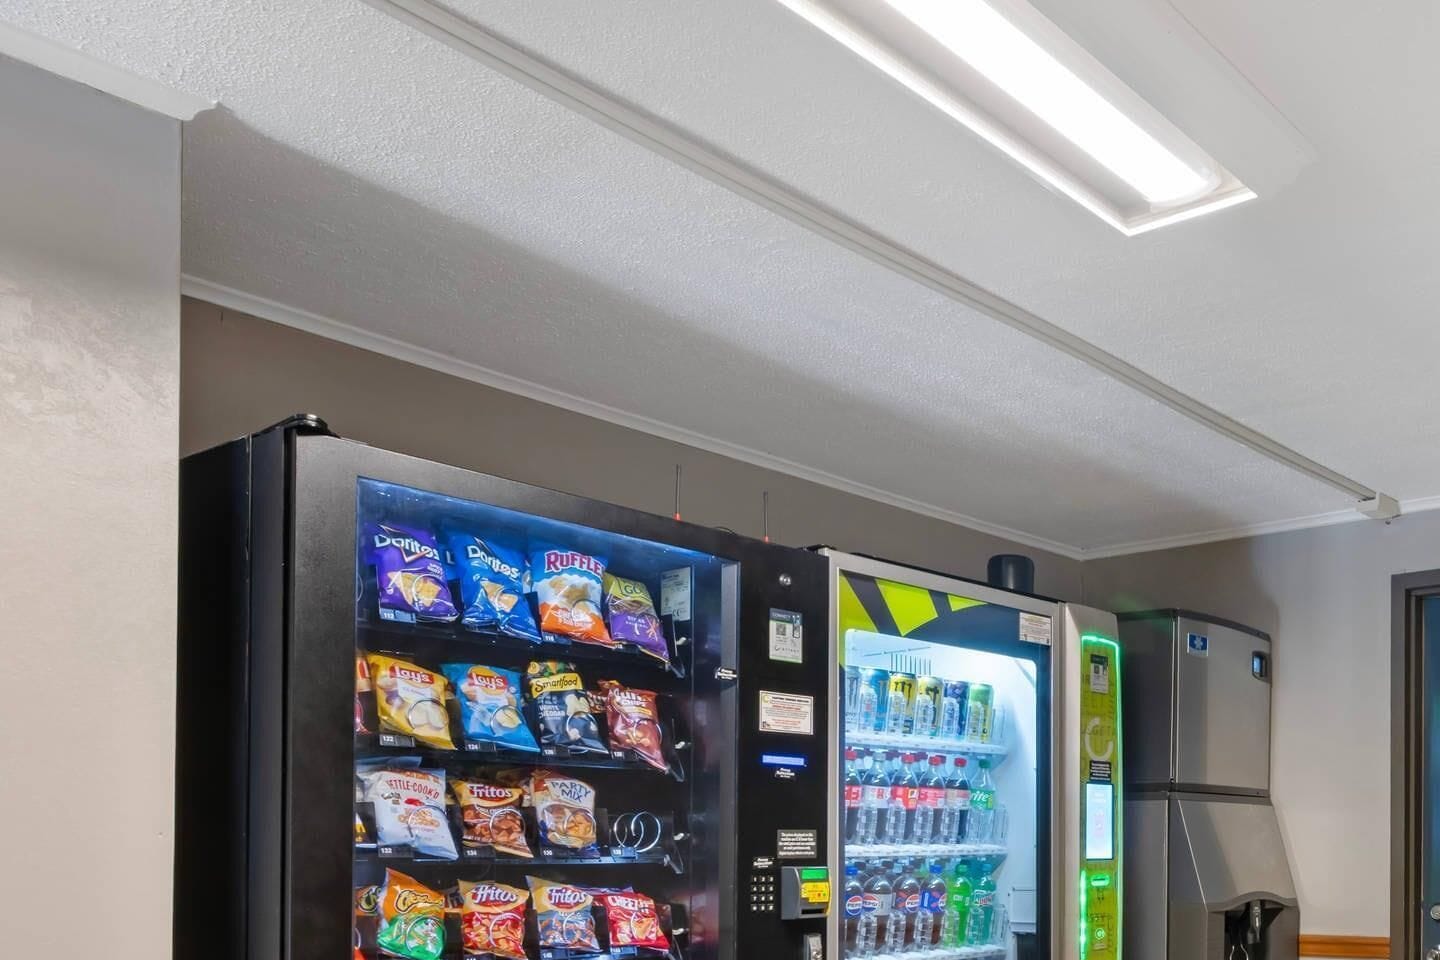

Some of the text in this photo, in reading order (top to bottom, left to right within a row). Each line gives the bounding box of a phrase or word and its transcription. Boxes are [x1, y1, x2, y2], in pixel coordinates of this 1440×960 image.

[374, 534, 440, 561] Doritos
[467, 545, 521, 578] Doritos
[395, 665, 432, 683] Lay's
[472, 672, 505, 690] Lay's
[534, 676, 578, 693] Smartfood
[470, 784, 512, 799] Fritos
[551, 781, 591, 798] PARTY
[561, 789, 583, 803] MIX
[472, 884, 518, 903] Fritos
[550, 886, 587, 906] Fritos
